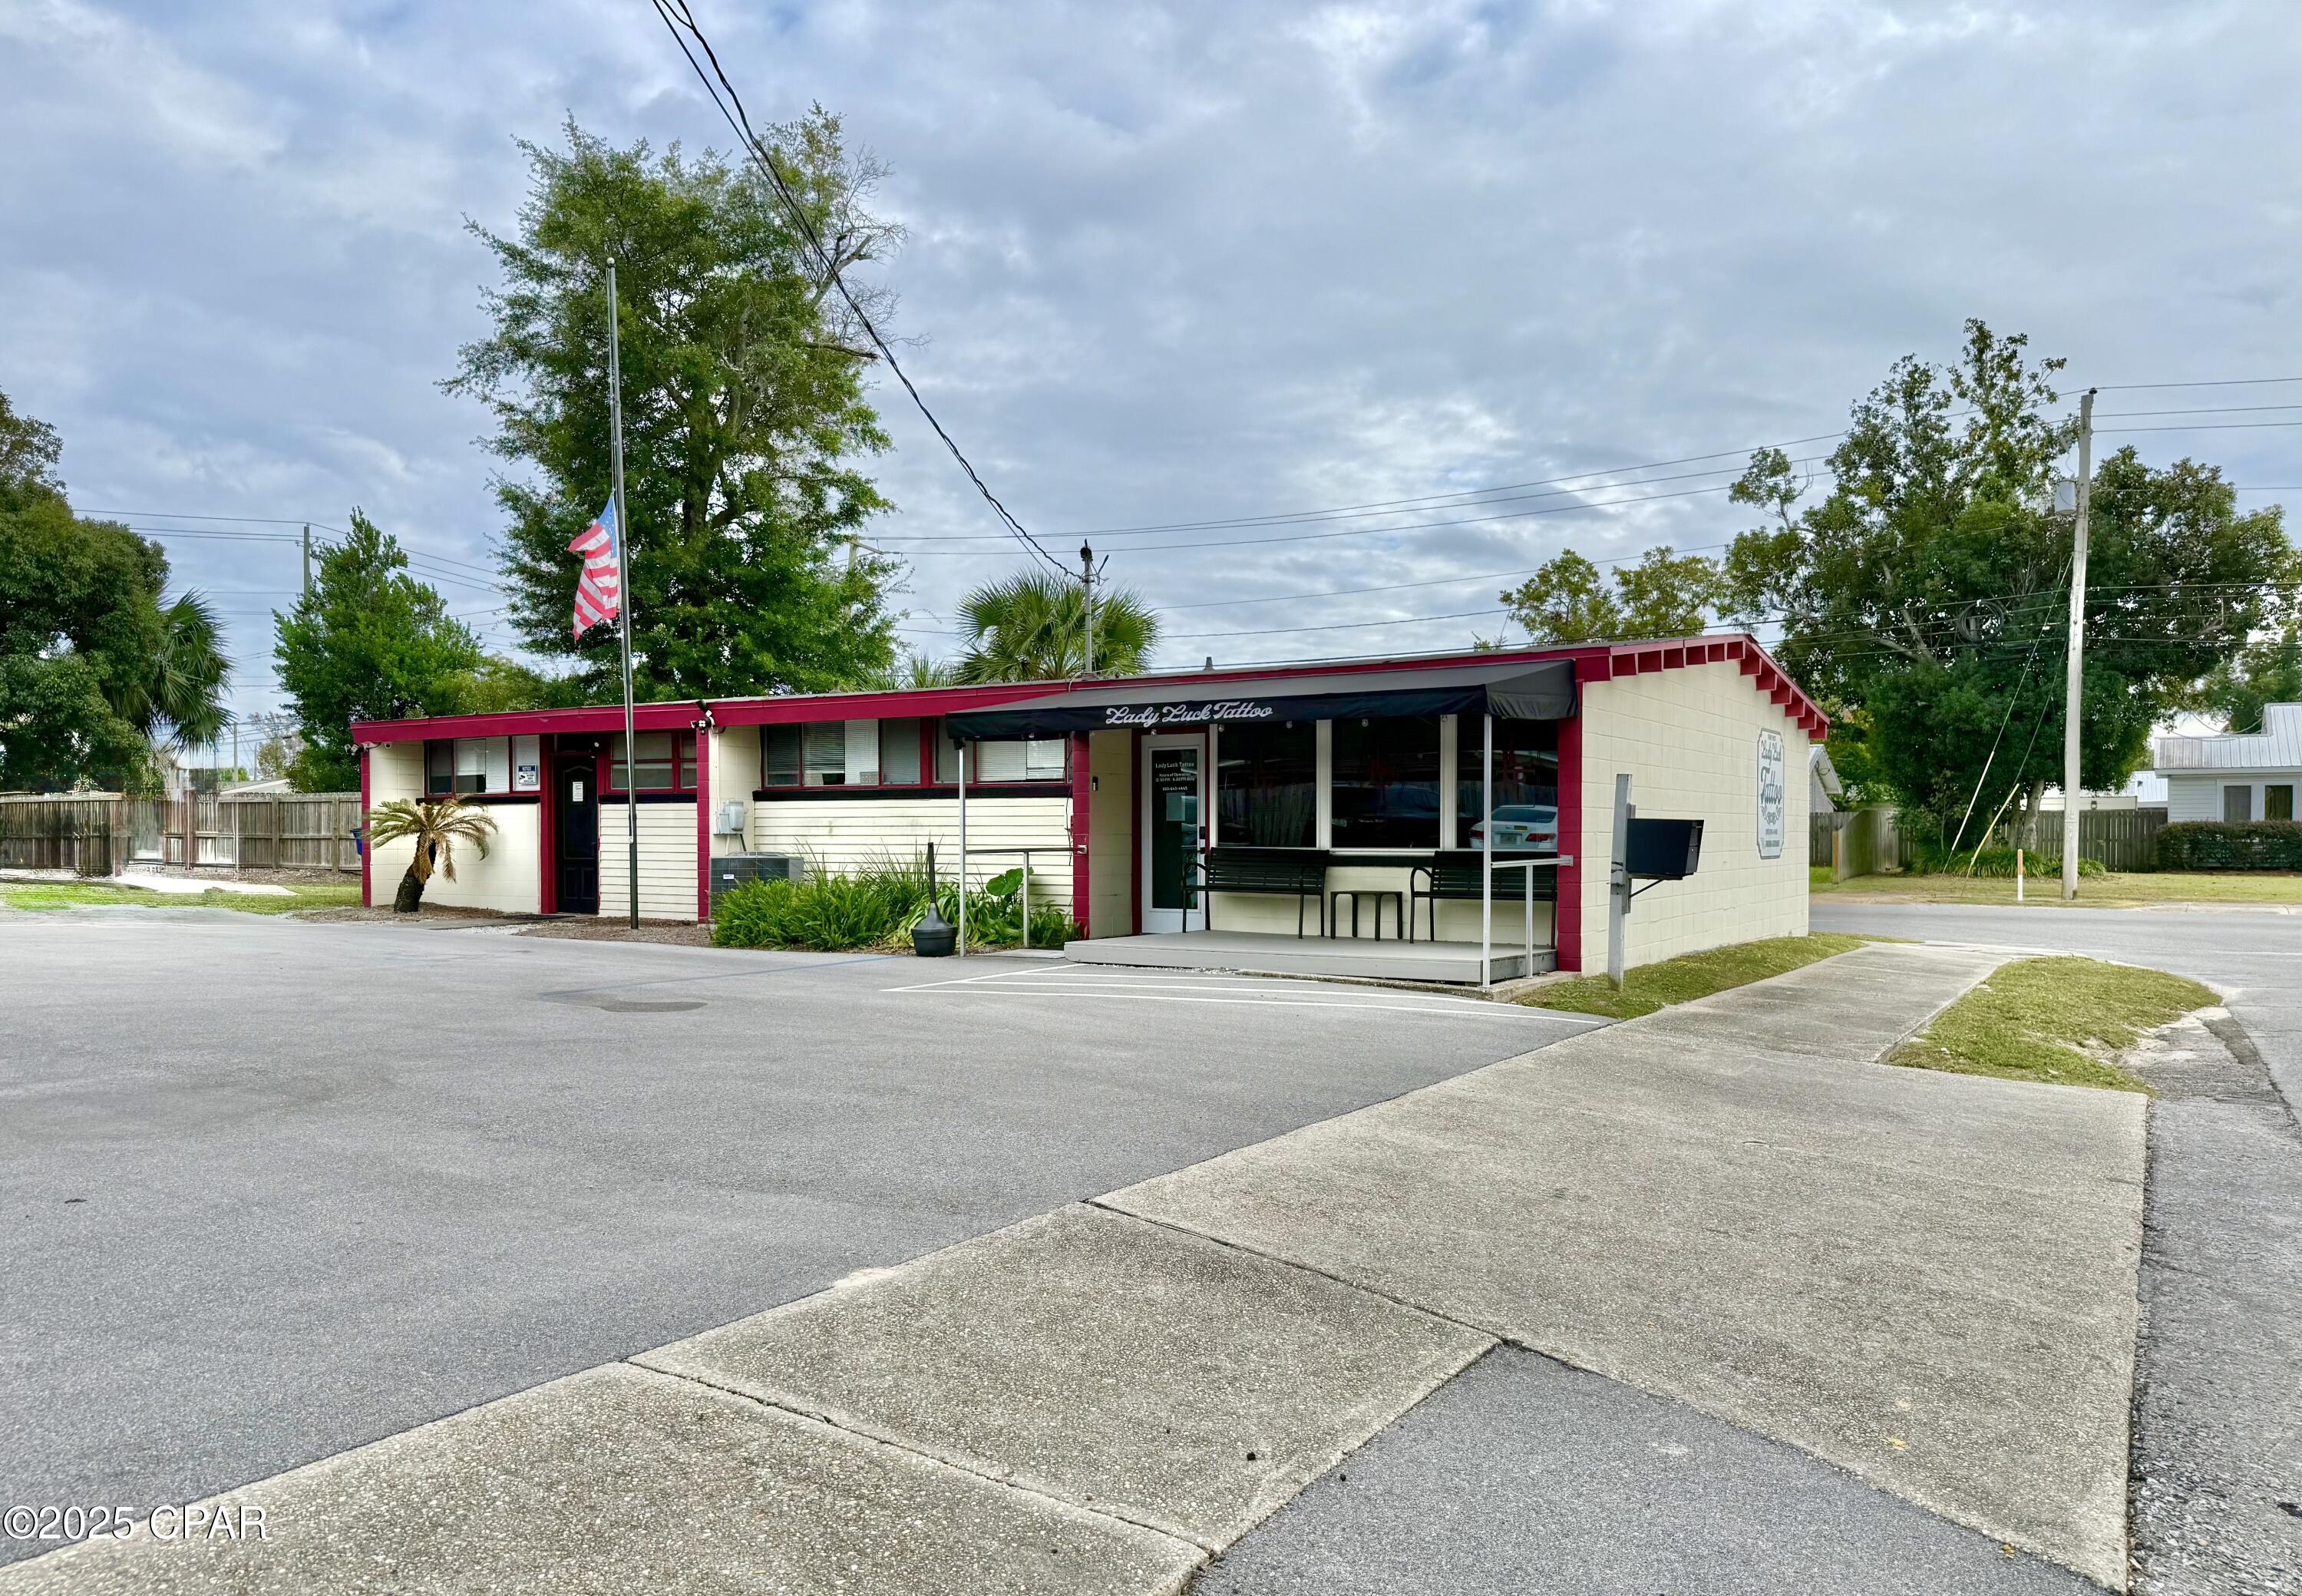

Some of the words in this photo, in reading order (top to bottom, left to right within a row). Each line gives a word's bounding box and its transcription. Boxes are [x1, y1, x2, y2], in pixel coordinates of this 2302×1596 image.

[1106, 706, 1159, 728] Lady
[1162, 704, 1213, 723] Luck
[1214, 701, 1273, 719] Tattoo
[1760, 766, 1782, 805] Tattoo
